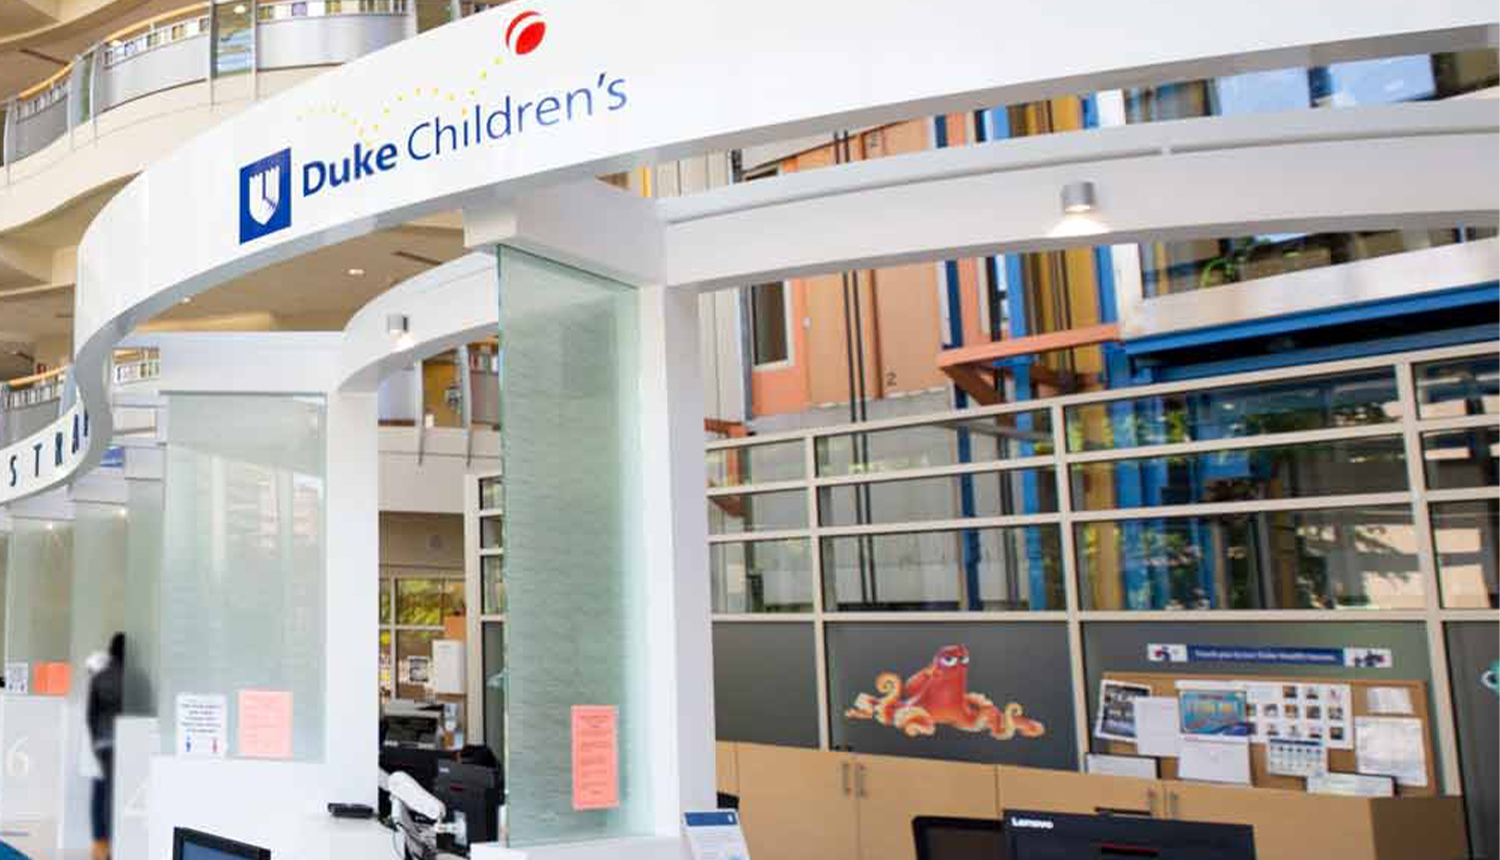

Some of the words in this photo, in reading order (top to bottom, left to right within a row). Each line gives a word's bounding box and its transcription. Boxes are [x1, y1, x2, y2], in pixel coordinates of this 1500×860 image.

[303, 142, 398, 198] Duke
[407, 73, 628, 161] Children's
[5, 736, 31, 777] 6
[1011, 816, 1054, 829] Lenovo
